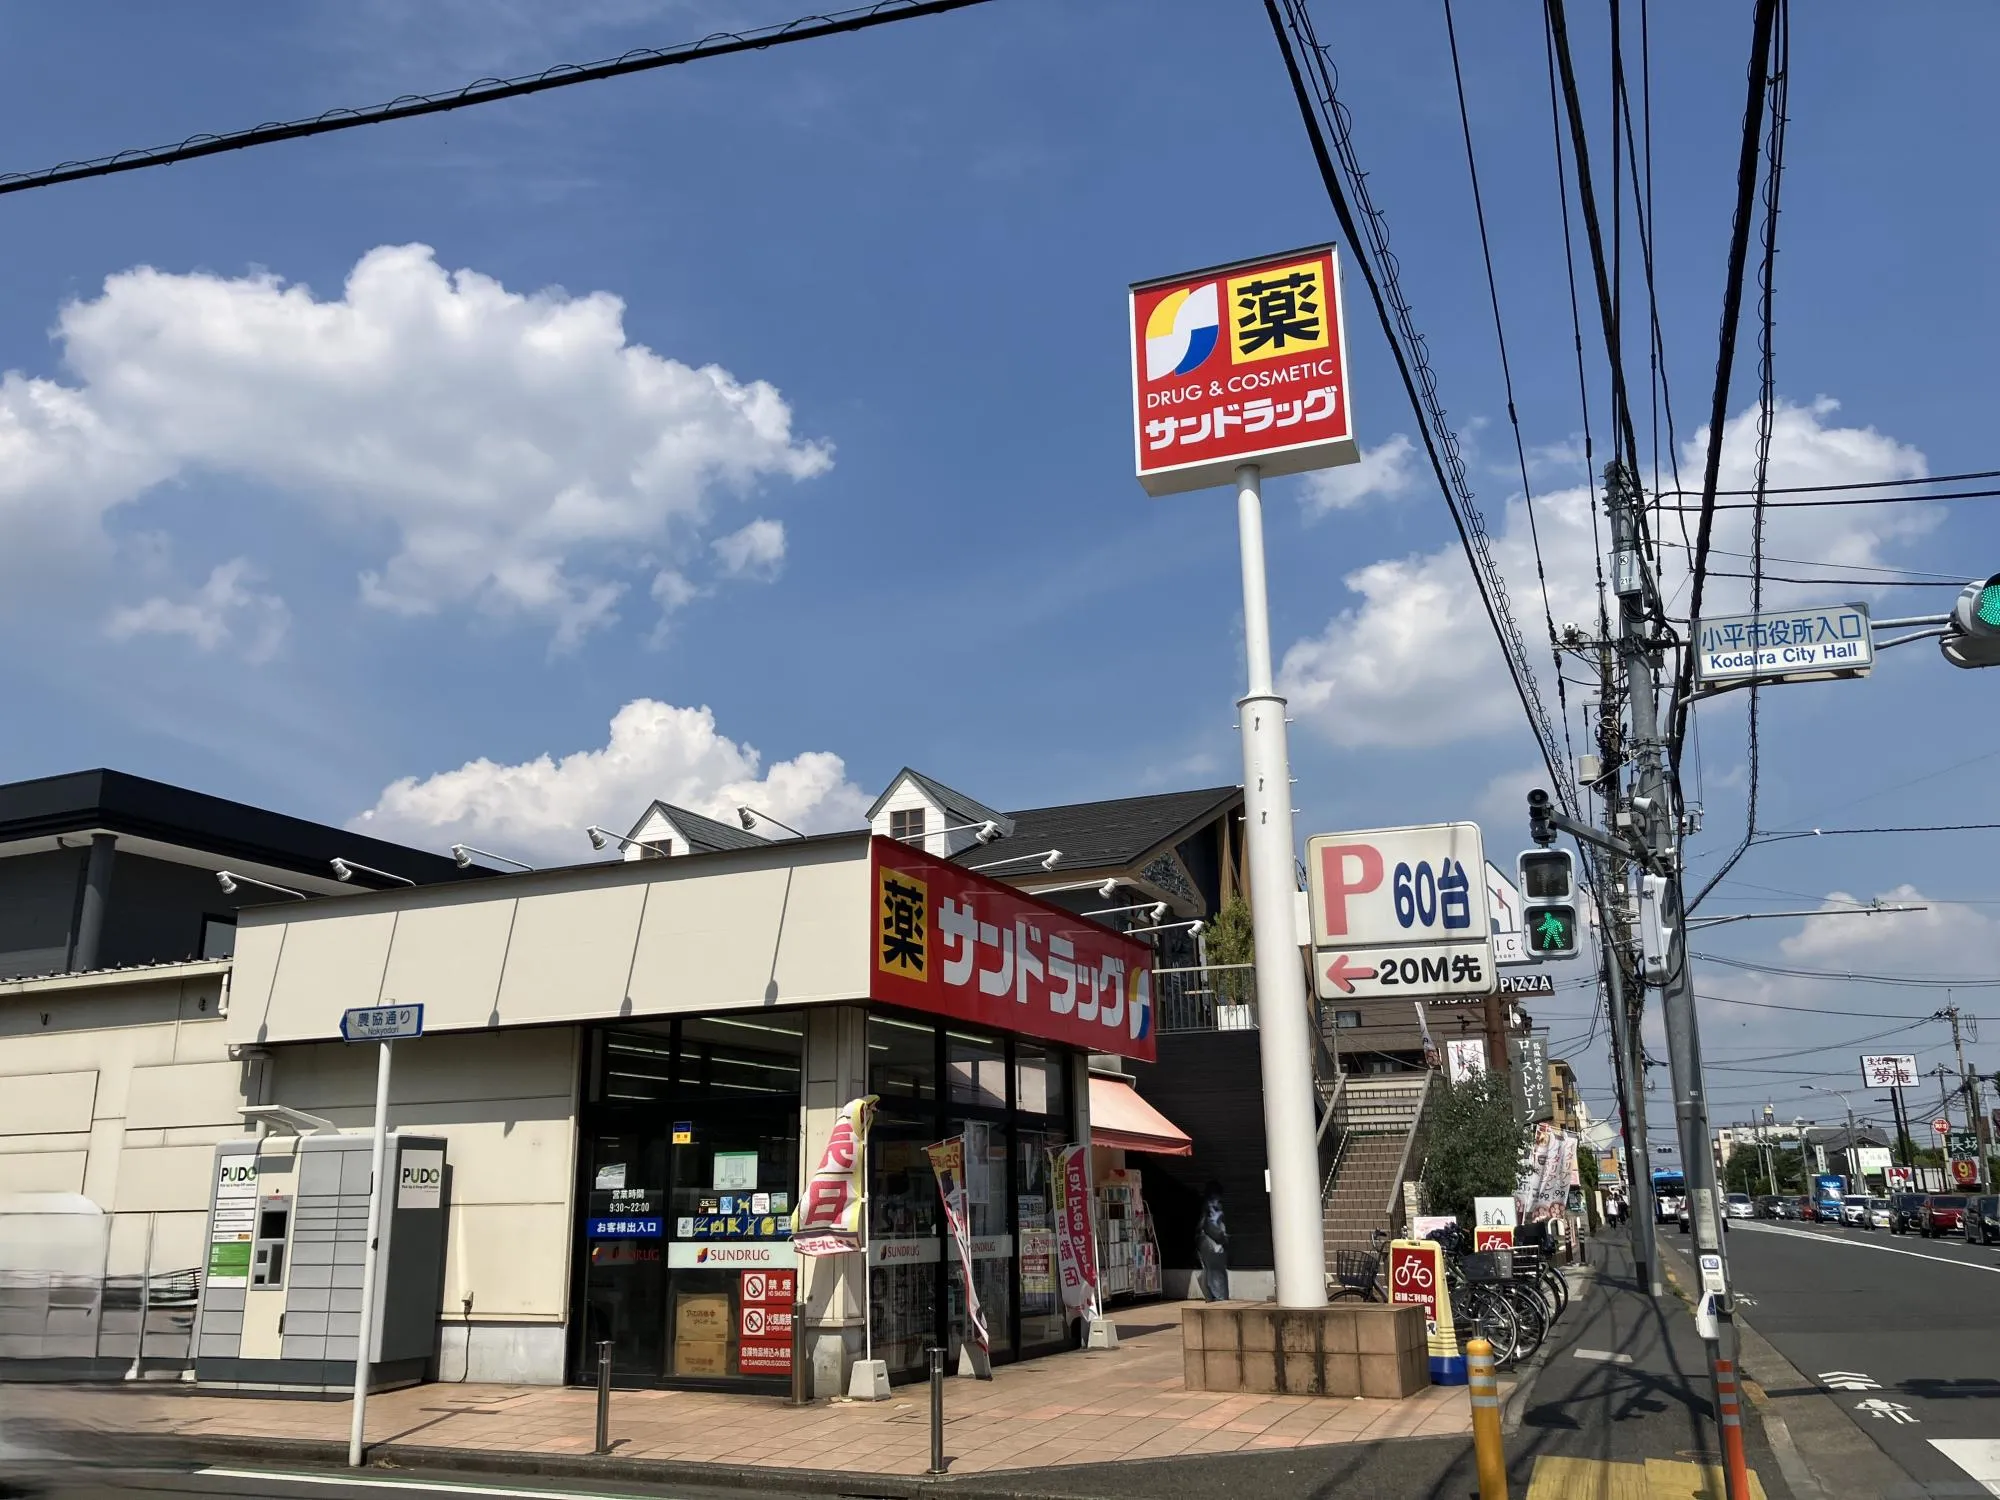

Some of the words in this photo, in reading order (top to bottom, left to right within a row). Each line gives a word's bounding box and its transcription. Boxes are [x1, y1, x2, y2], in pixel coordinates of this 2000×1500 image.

[1237, 272, 1320, 356] 薬
[1147, 384, 1202, 409] DRUG
[1209, 380, 1224, 398] &
[1227, 359, 1333, 392] COSMETIC
[1145, 385, 1338, 451] サンドラッグ
[1702, 614, 1862, 652] 小平市役所入口
[1711, 651, 1776, 670] Kodaira
[1783, 647, 1816, 664] City
[1824, 643, 1857, 659] Hall
[1321, 844, 1384, 936] P
[1394, 857, 1471, 929] 60台
[884, 879, 924, 972] 薬
[938, 897, 1125, 1028] サンドラッグ
[1380, 955, 1482, 985] 20M先
[1500, 975, 1551, 993] PIZZA
[357, 1010, 411, 1027] 農協通り
[1518, 1040, 1536, 1121] ローストビーフ
[221, 1166, 257, 1182] PUDO
[402, 1168, 440, 1184] PUDO
[597, 1222, 657, 1233] お客様出入口
[710, 1249, 770, 1262] SUNDRUG
